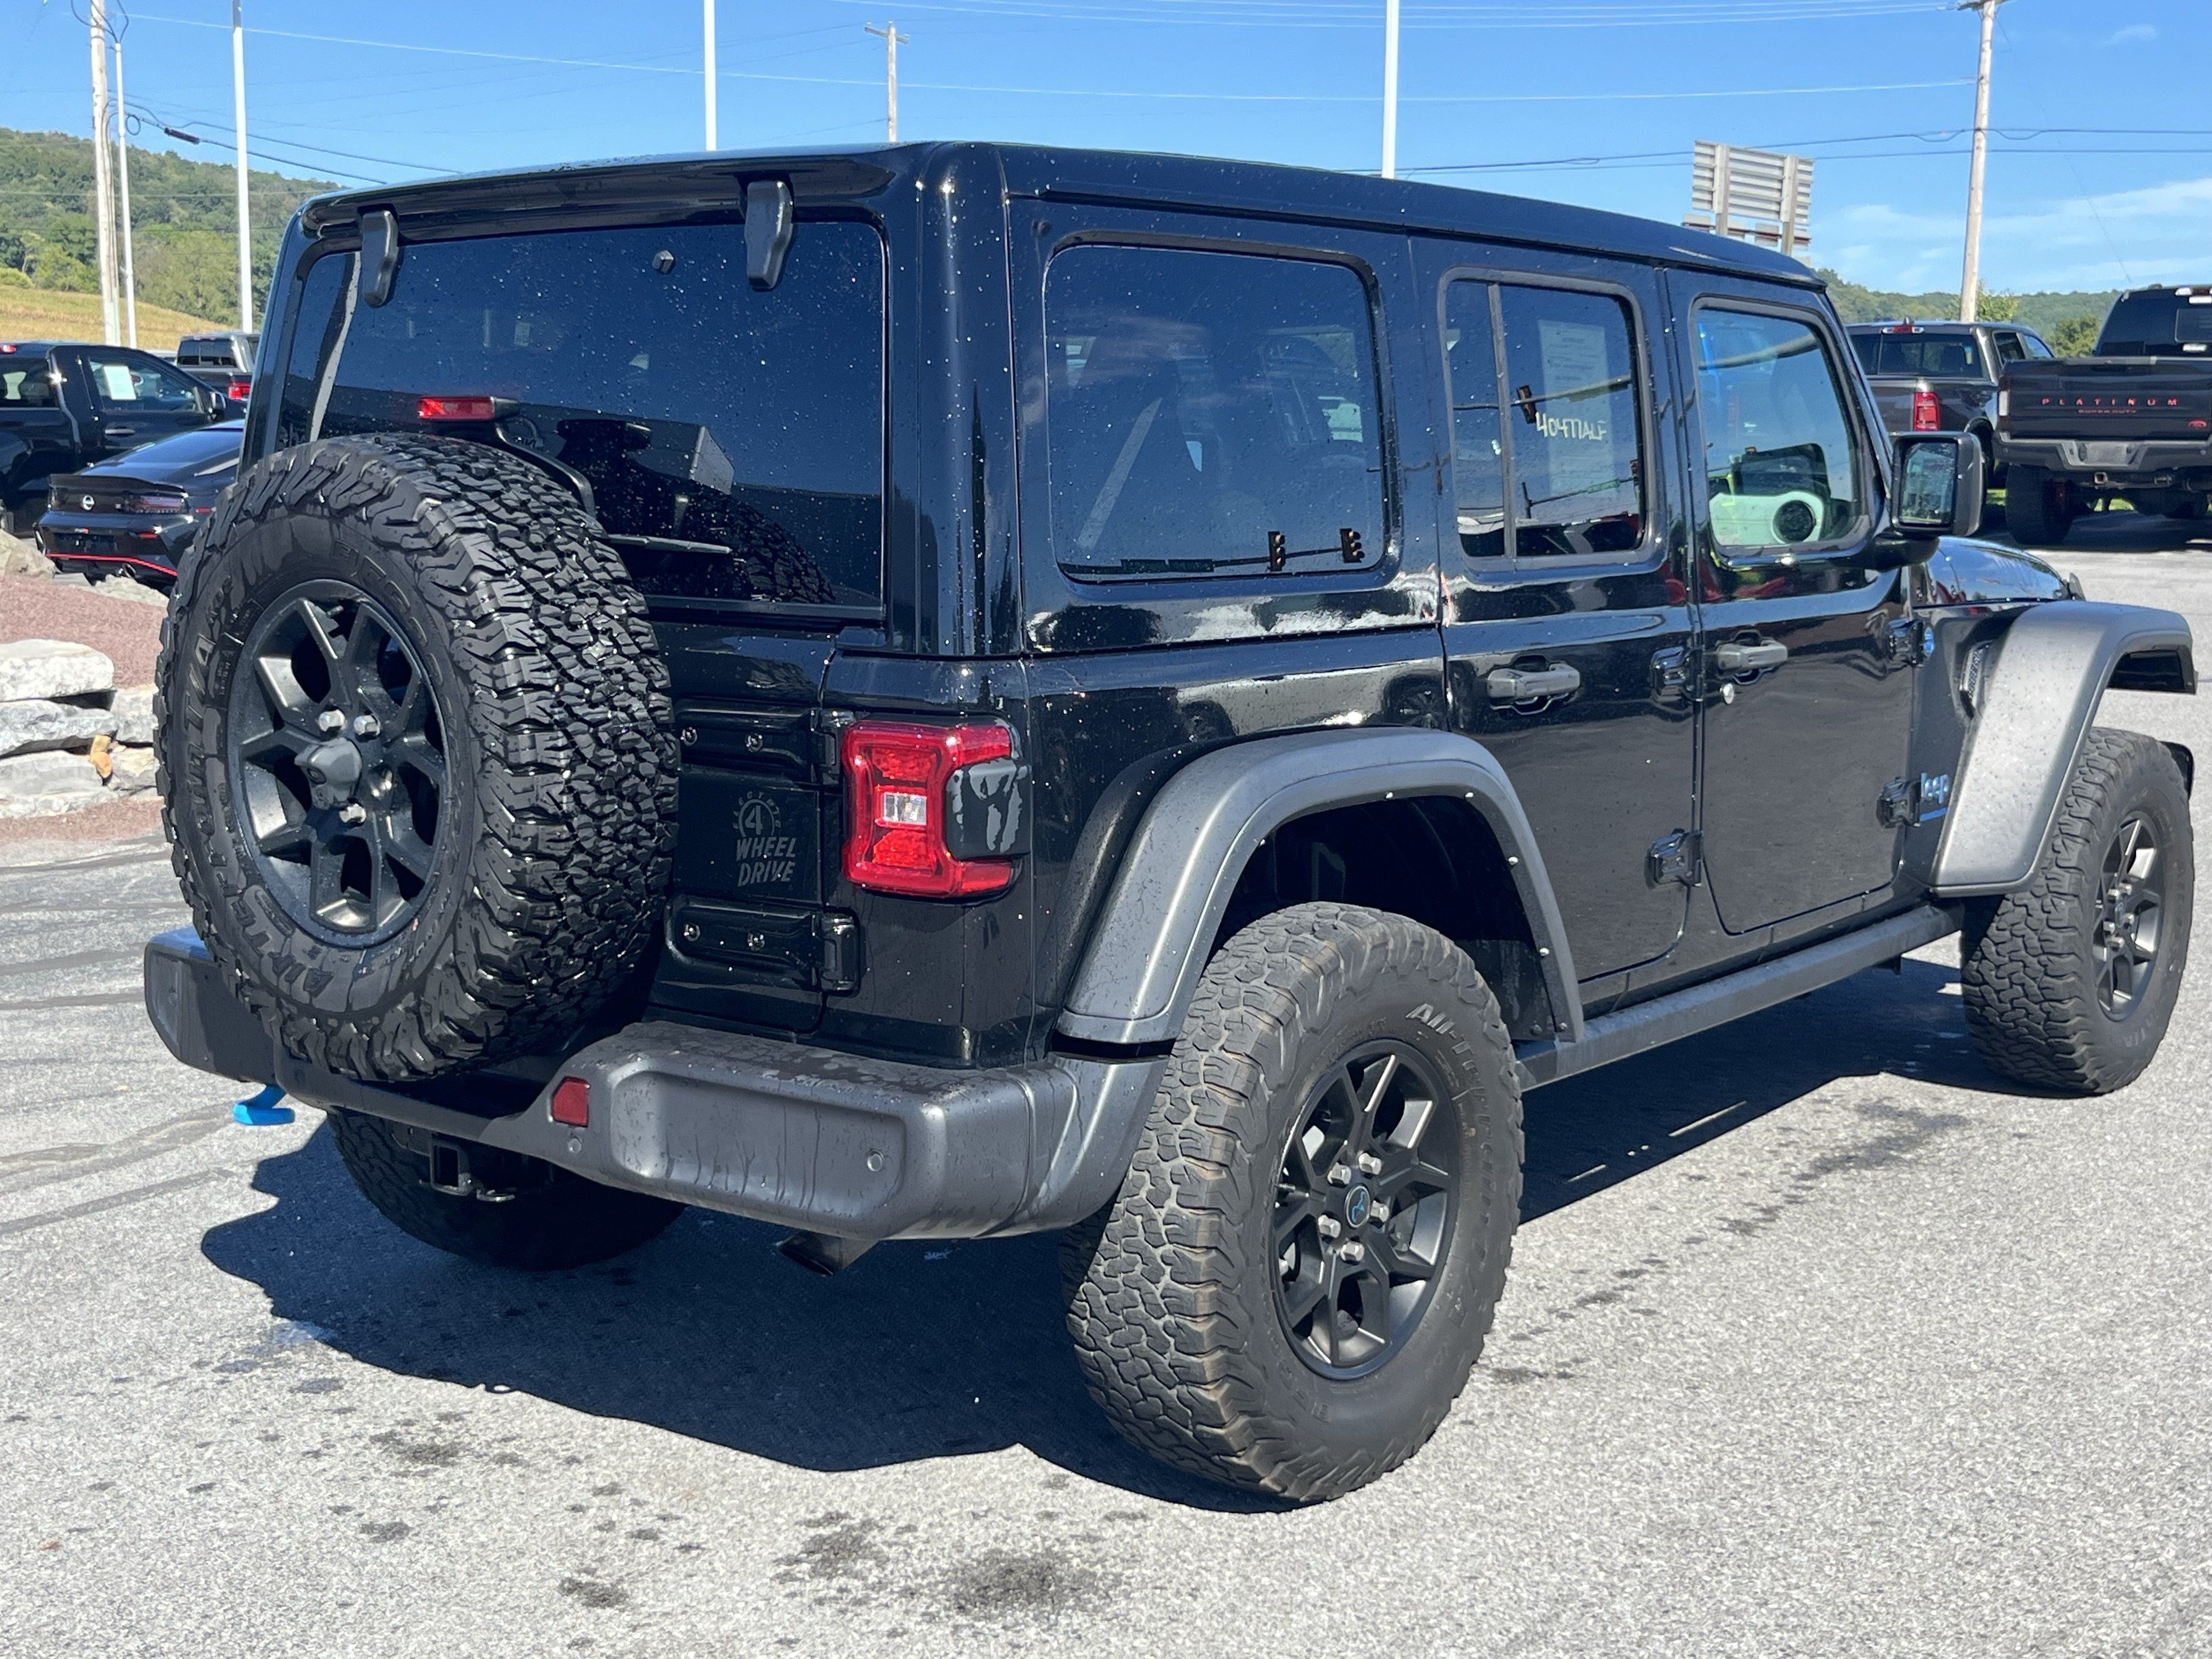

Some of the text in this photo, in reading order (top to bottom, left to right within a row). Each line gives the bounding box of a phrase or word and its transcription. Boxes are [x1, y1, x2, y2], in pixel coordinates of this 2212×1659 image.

[745, 805, 763, 835] 4
[736, 837, 796, 861] WHEEL
[737, 861, 795, 887] DRIVE
